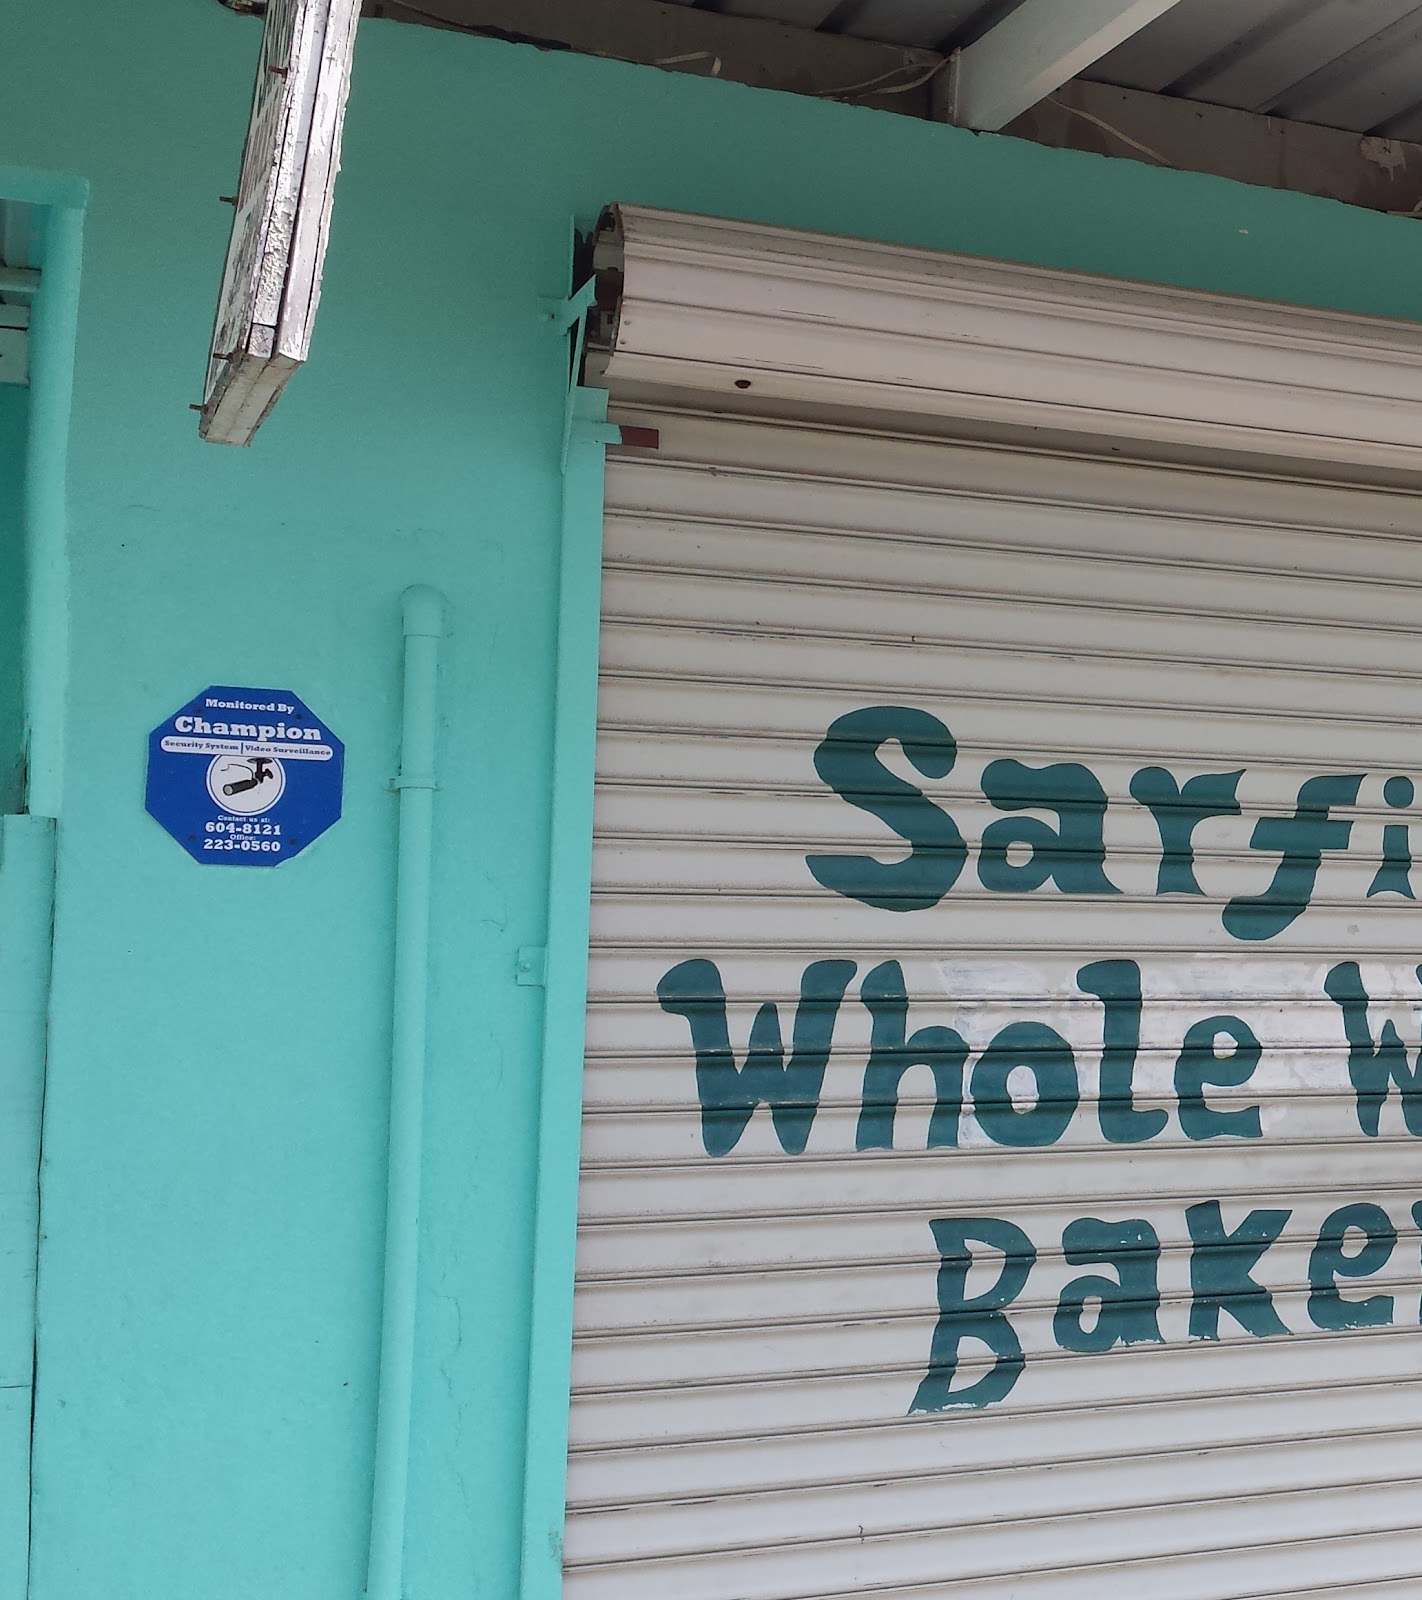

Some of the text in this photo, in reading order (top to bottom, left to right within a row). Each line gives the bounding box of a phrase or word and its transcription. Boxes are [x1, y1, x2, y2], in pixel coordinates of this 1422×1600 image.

[205, 698, 295, 714] Monitored By
[174, 715, 321, 741] Champion
[164, 740, 239, 751] Security System
[273, 747, 331, 756] Surveillance
[205, 821, 281, 835] 604-8121
[203, 838, 281, 852] 223-0560
[655, 958, 1264, 1158] Whole
